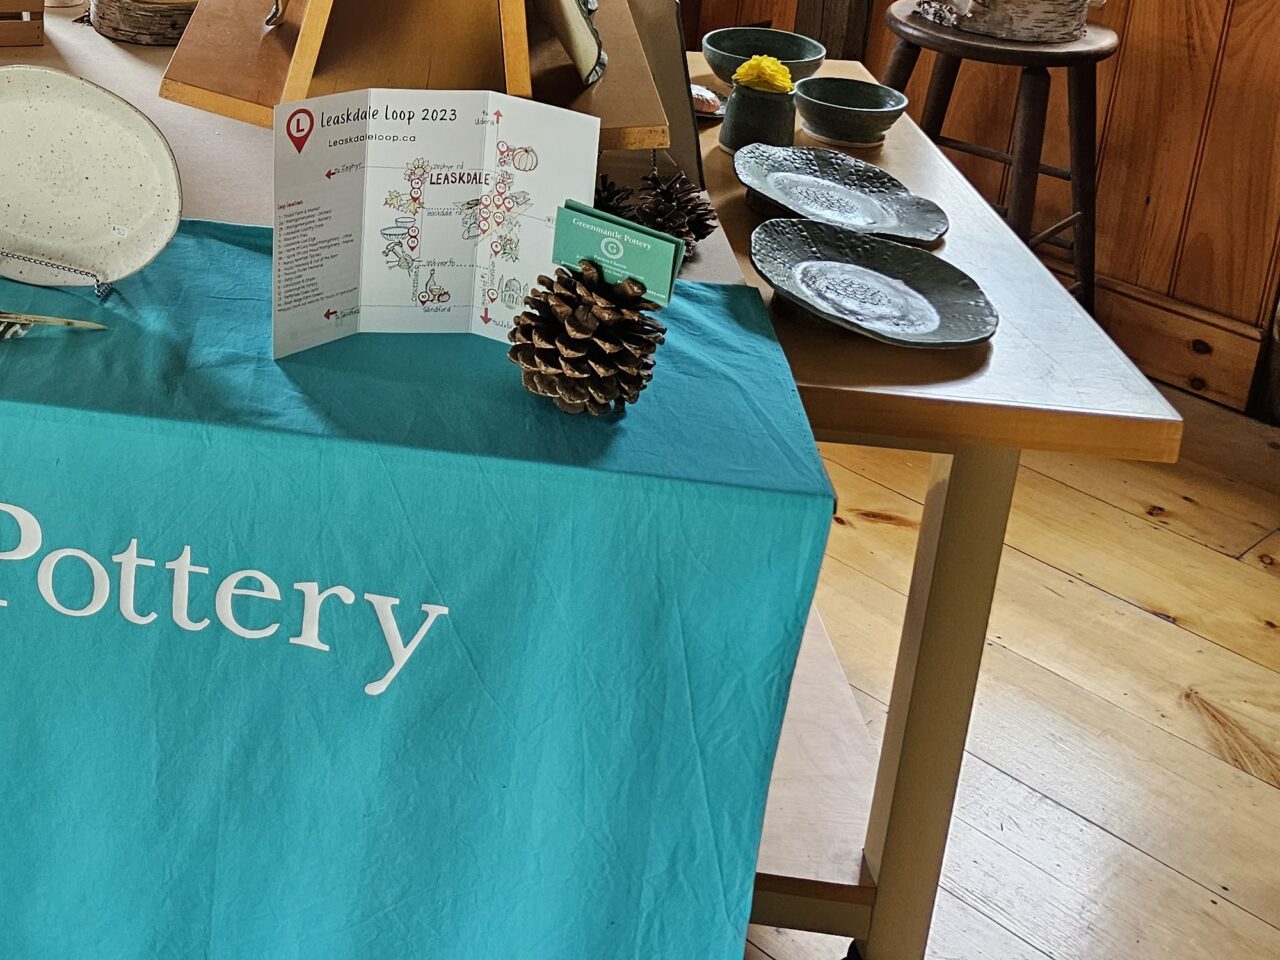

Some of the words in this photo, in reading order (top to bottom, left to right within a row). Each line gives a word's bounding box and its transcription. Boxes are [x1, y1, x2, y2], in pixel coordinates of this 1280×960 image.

[320, 105, 379, 128] Leaskdale
[384, 104, 415, 125] Loop
[421, 109, 458, 121] 2023
[296, 118, 305, 133] L
[328, 133, 417, 148] Leaskdaleloop.ca
[429, 172, 491, 186] LEASKDALE
[572, 217, 622, 240] Greenmantle
[624, 234, 652, 250] Pottery
